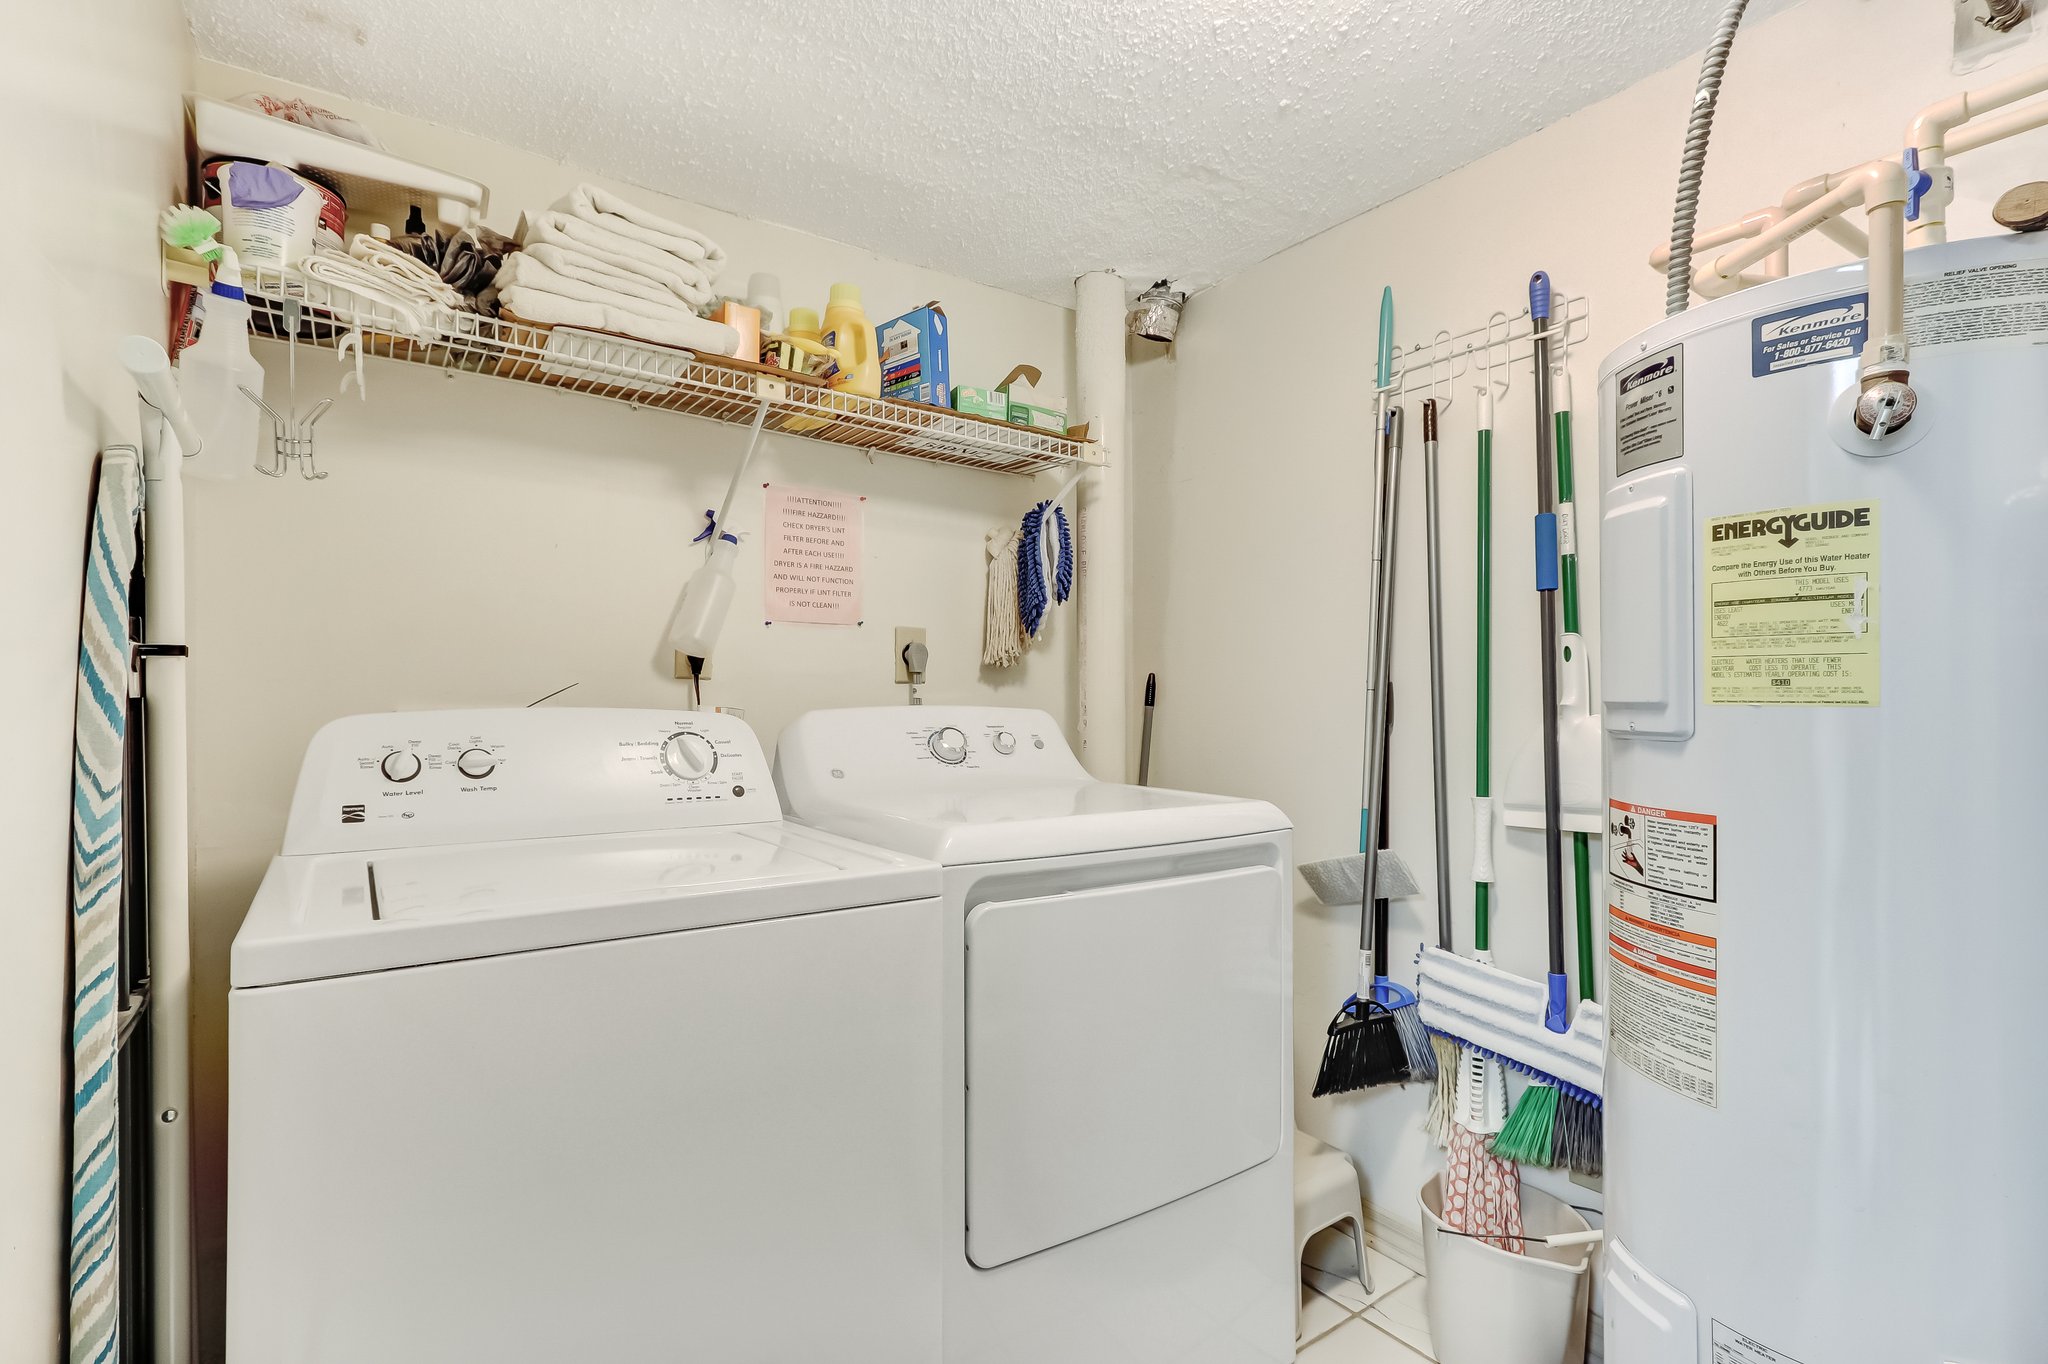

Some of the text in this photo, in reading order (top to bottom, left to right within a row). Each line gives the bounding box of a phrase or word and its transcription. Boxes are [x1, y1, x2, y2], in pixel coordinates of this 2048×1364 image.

[1989, 263, 2018, 271] OPENING
[1779, 313, 1861, 336] Kenmore
[1763, 327, 1861, 354] For Sales or Service Call
[1774, 337, 1850, 360] 1-800-877-6420
[1627, 365, 1673, 391] Kenmore
[783, 521, 804, 529] CHECK
[805, 524, 831, 532] DRYER'S
[1712, 507, 1870, 546] ENERGYGUIDE
[805, 537, 829, 545] BEFORE
[773, 560, 795, 568] DRYER
[1712, 564, 1739, 573] Compare
[1753, 560, 1777, 569] Energy
[1779, 558, 1793, 566] Use
[1738, 570, 1752, 578] with
[1754, 568, 1776, 577] Others
[1778, 566, 1802, 575] Before
[821, 577, 854, 585] FUNCTION
[1795, 578, 1810, 586] THIS
[775, 586, 808, 595] PROPERLY
[832, 590, 852, 598] FILTER
[1637, 807, 1667, 818] DANGER
